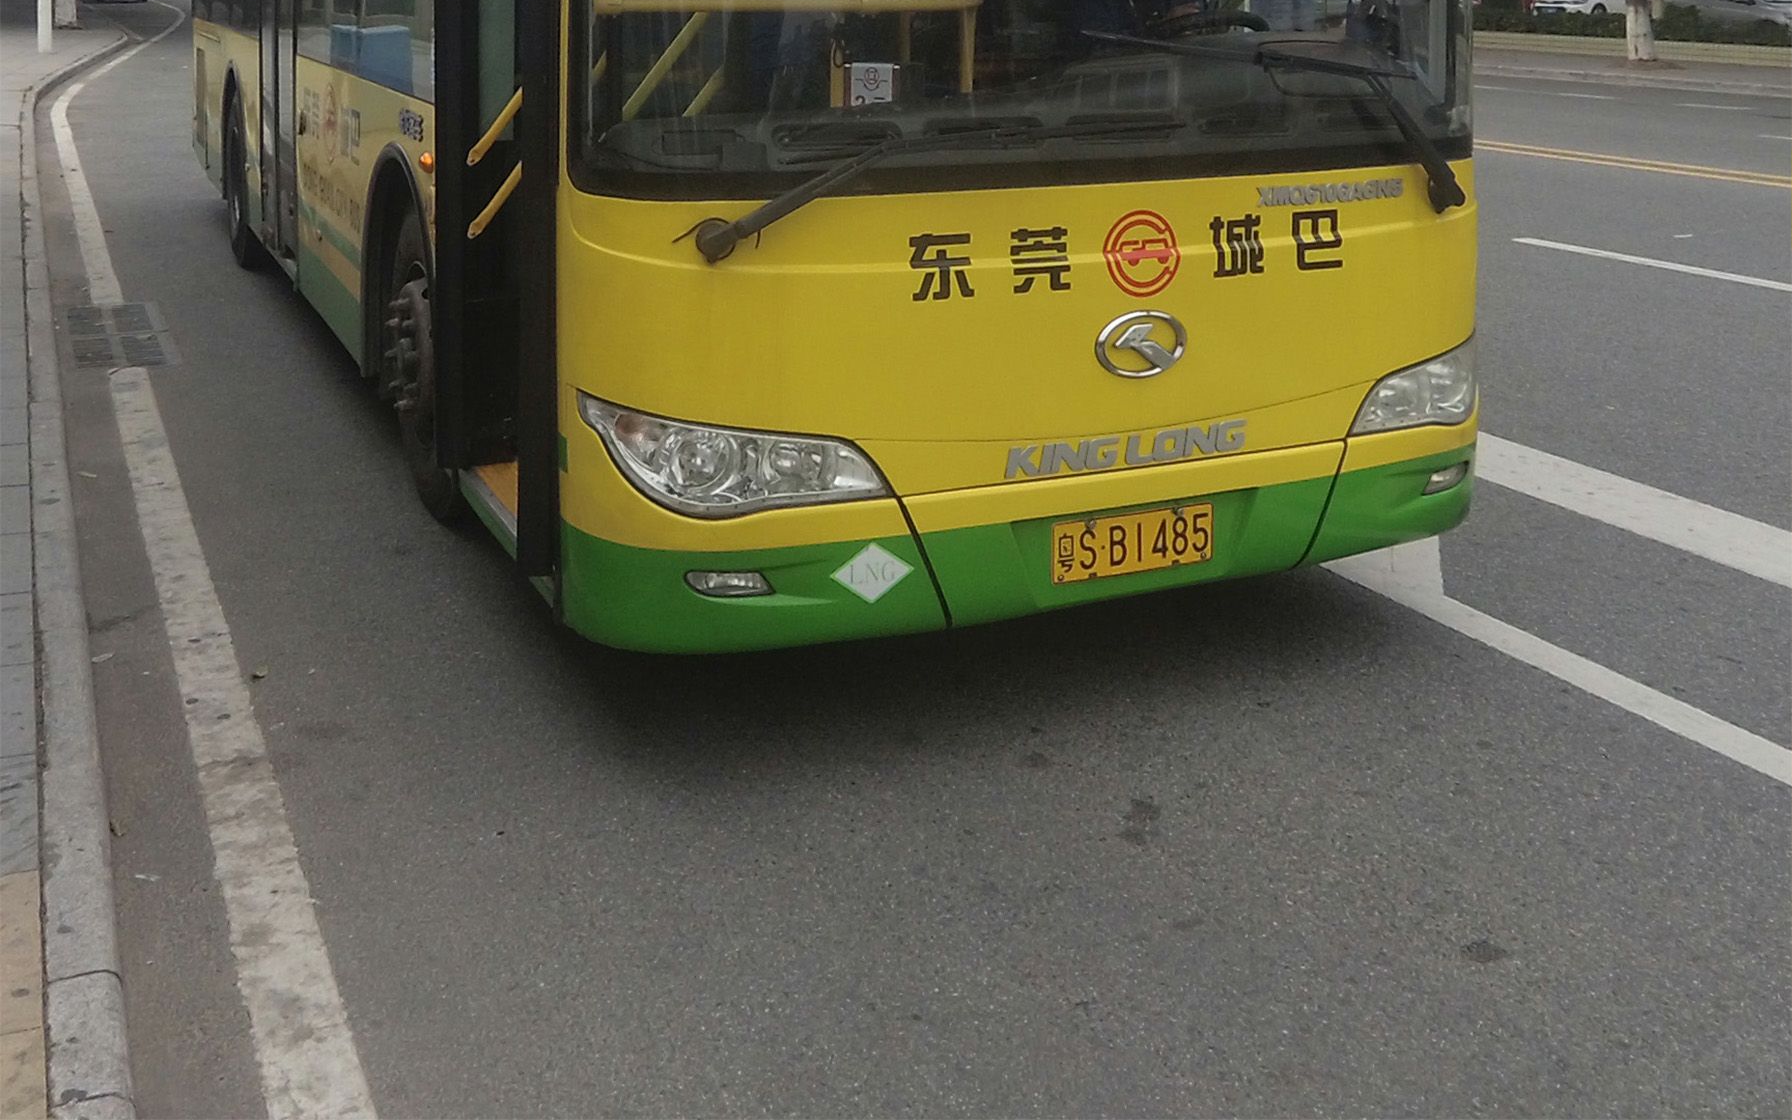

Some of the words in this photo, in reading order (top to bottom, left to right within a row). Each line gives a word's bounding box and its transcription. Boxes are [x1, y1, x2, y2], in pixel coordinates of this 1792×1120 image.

[909, 227, 1072, 301] 东莞
[1209, 209, 1343, 278] 城巴
[1005, 437, 1121, 479] KING
[1124, 418, 1247, 466] LONG
[850, 560, 896, 585] LNG
